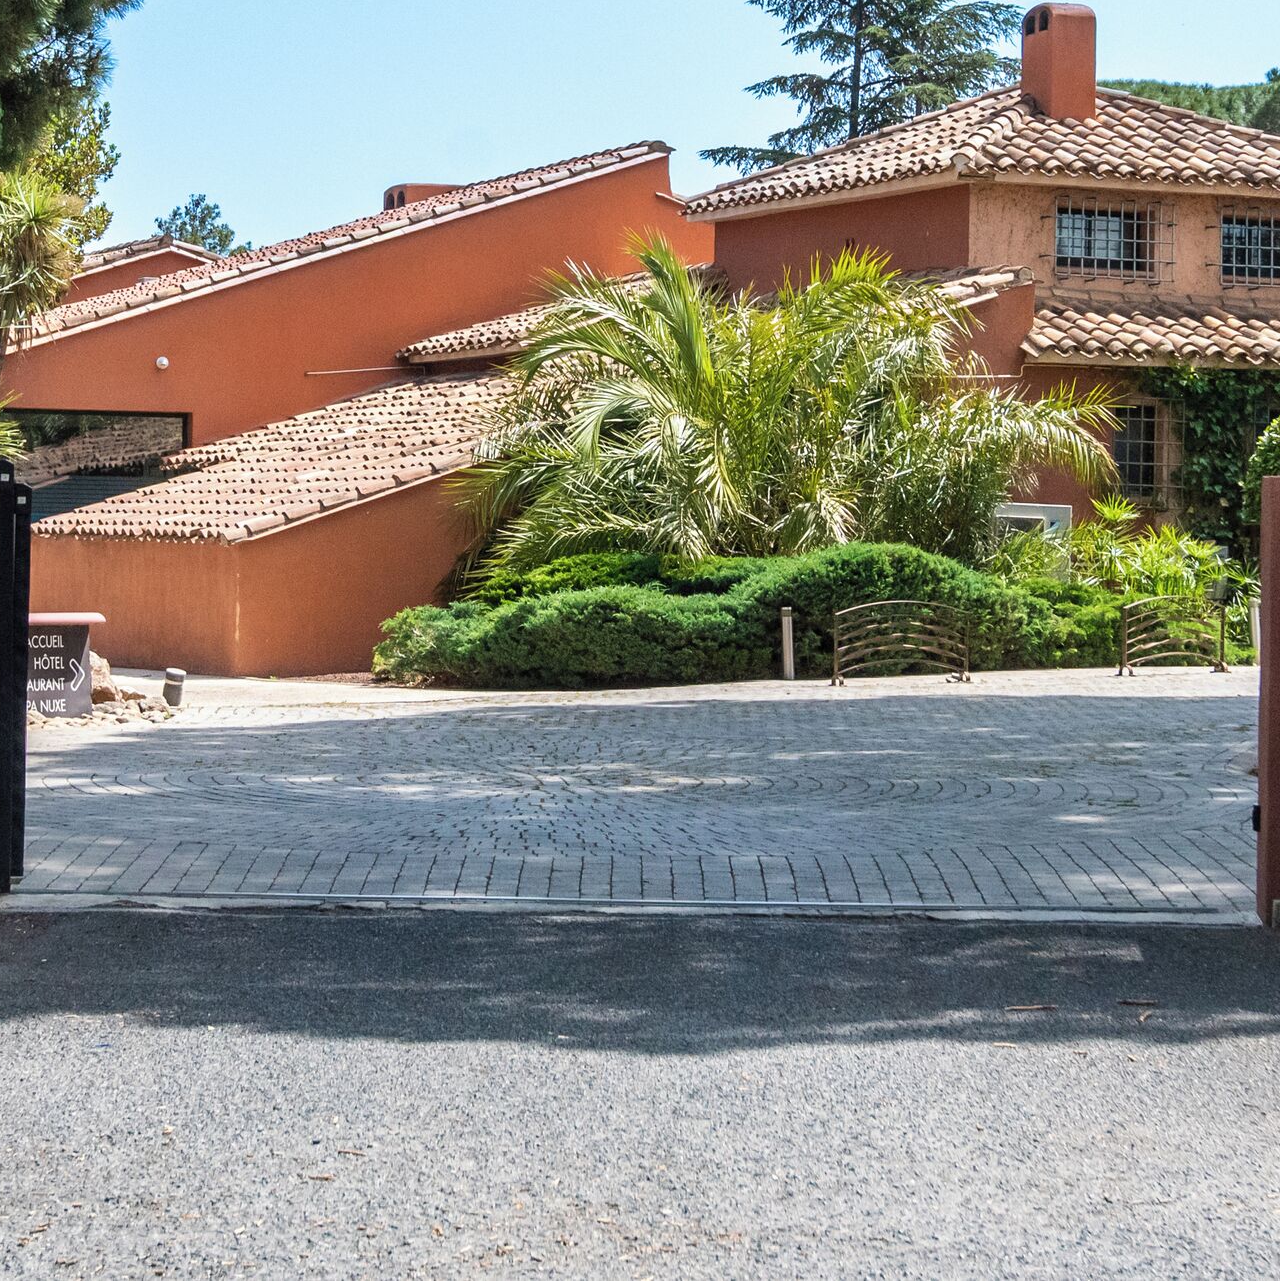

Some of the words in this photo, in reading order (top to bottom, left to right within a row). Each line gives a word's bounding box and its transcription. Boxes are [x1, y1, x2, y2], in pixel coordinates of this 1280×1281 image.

[33, 653, 65, 670] HÔTEL
[26, 678, 65, 692] AURANT
[26, 700, 37, 713] PA
[40, 699, 66, 713] NUXE
